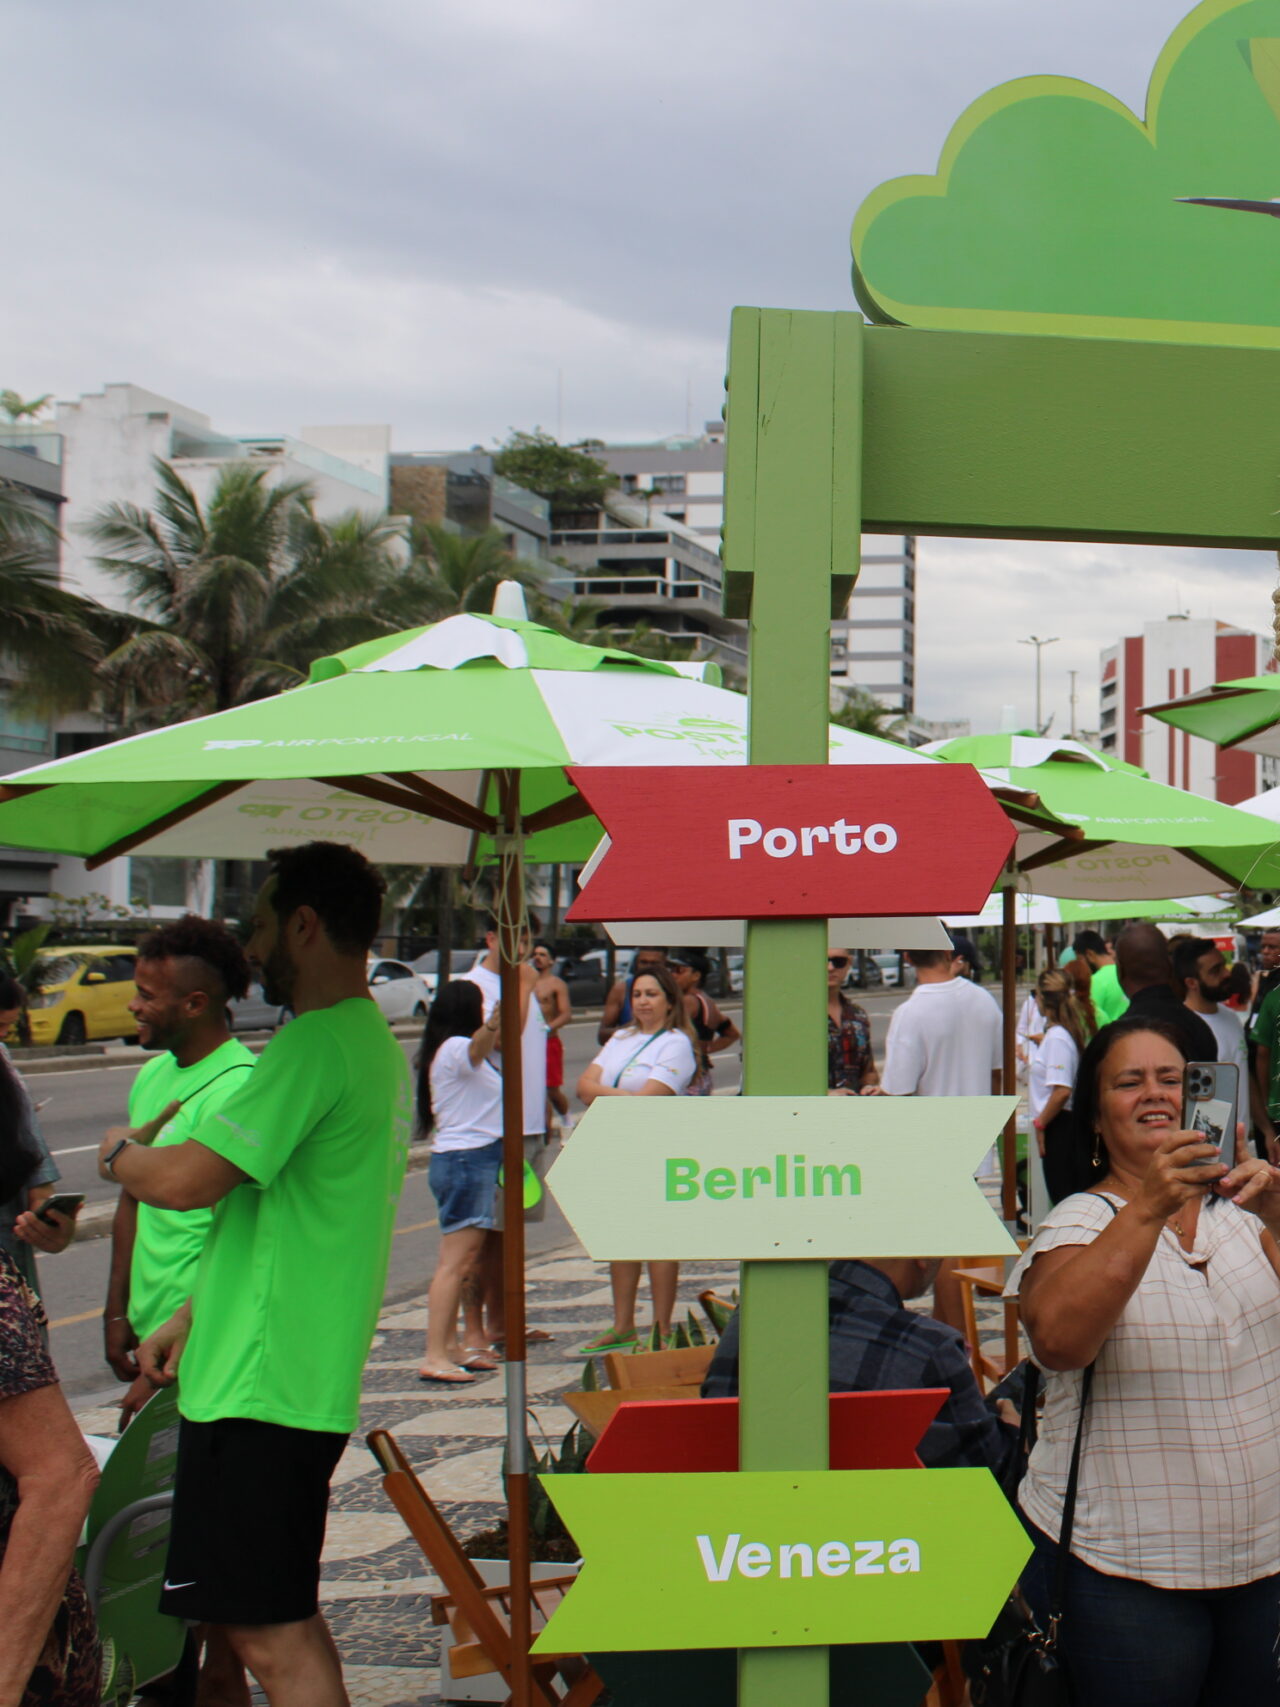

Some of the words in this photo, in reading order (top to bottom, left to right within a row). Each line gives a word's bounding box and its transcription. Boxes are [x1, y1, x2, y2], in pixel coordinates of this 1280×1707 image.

[728, 818, 898, 860] Porto
[665, 1154, 862, 1202] Berlim
[696, 1533, 921, 1582] Veneza
